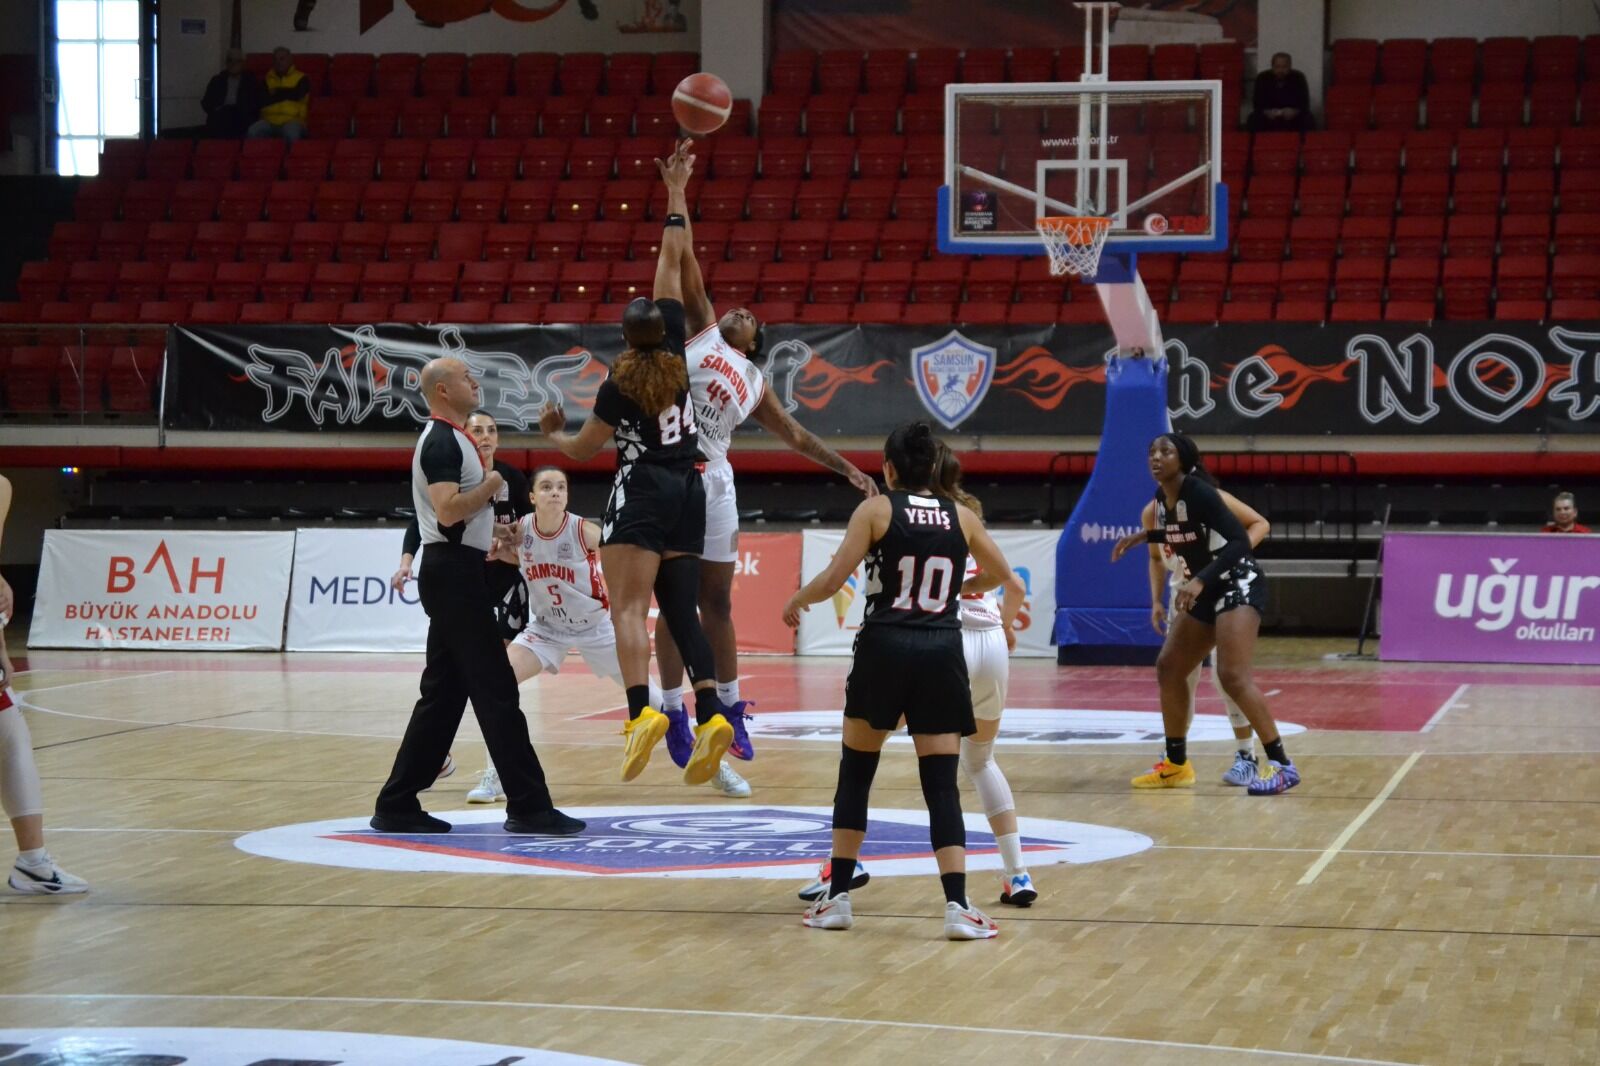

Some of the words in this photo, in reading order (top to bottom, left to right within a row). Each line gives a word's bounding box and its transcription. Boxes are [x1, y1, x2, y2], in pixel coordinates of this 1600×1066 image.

[933, 354, 975, 366] SAMSUN
[245, 325, 592, 430] FAIRES
[700, 354, 748, 406] SAMSUN
[706, 379, 731, 411] 44
[658, 394, 697, 445] 84
[904, 507, 951, 530] YETİŞ
[107, 539, 226, 594] BAH
[526, 563, 575, 584] SAMSUN
[547, 584, 562, 606] 5
[891, 556, 954, 613] 10
[1435, 558, 1600, 631] uğur
[64, 601, 139, 620] BÜYÜK
[146, 604, 258, 620] ANADOLU
[1515, 622, 1595, 641] okulları
